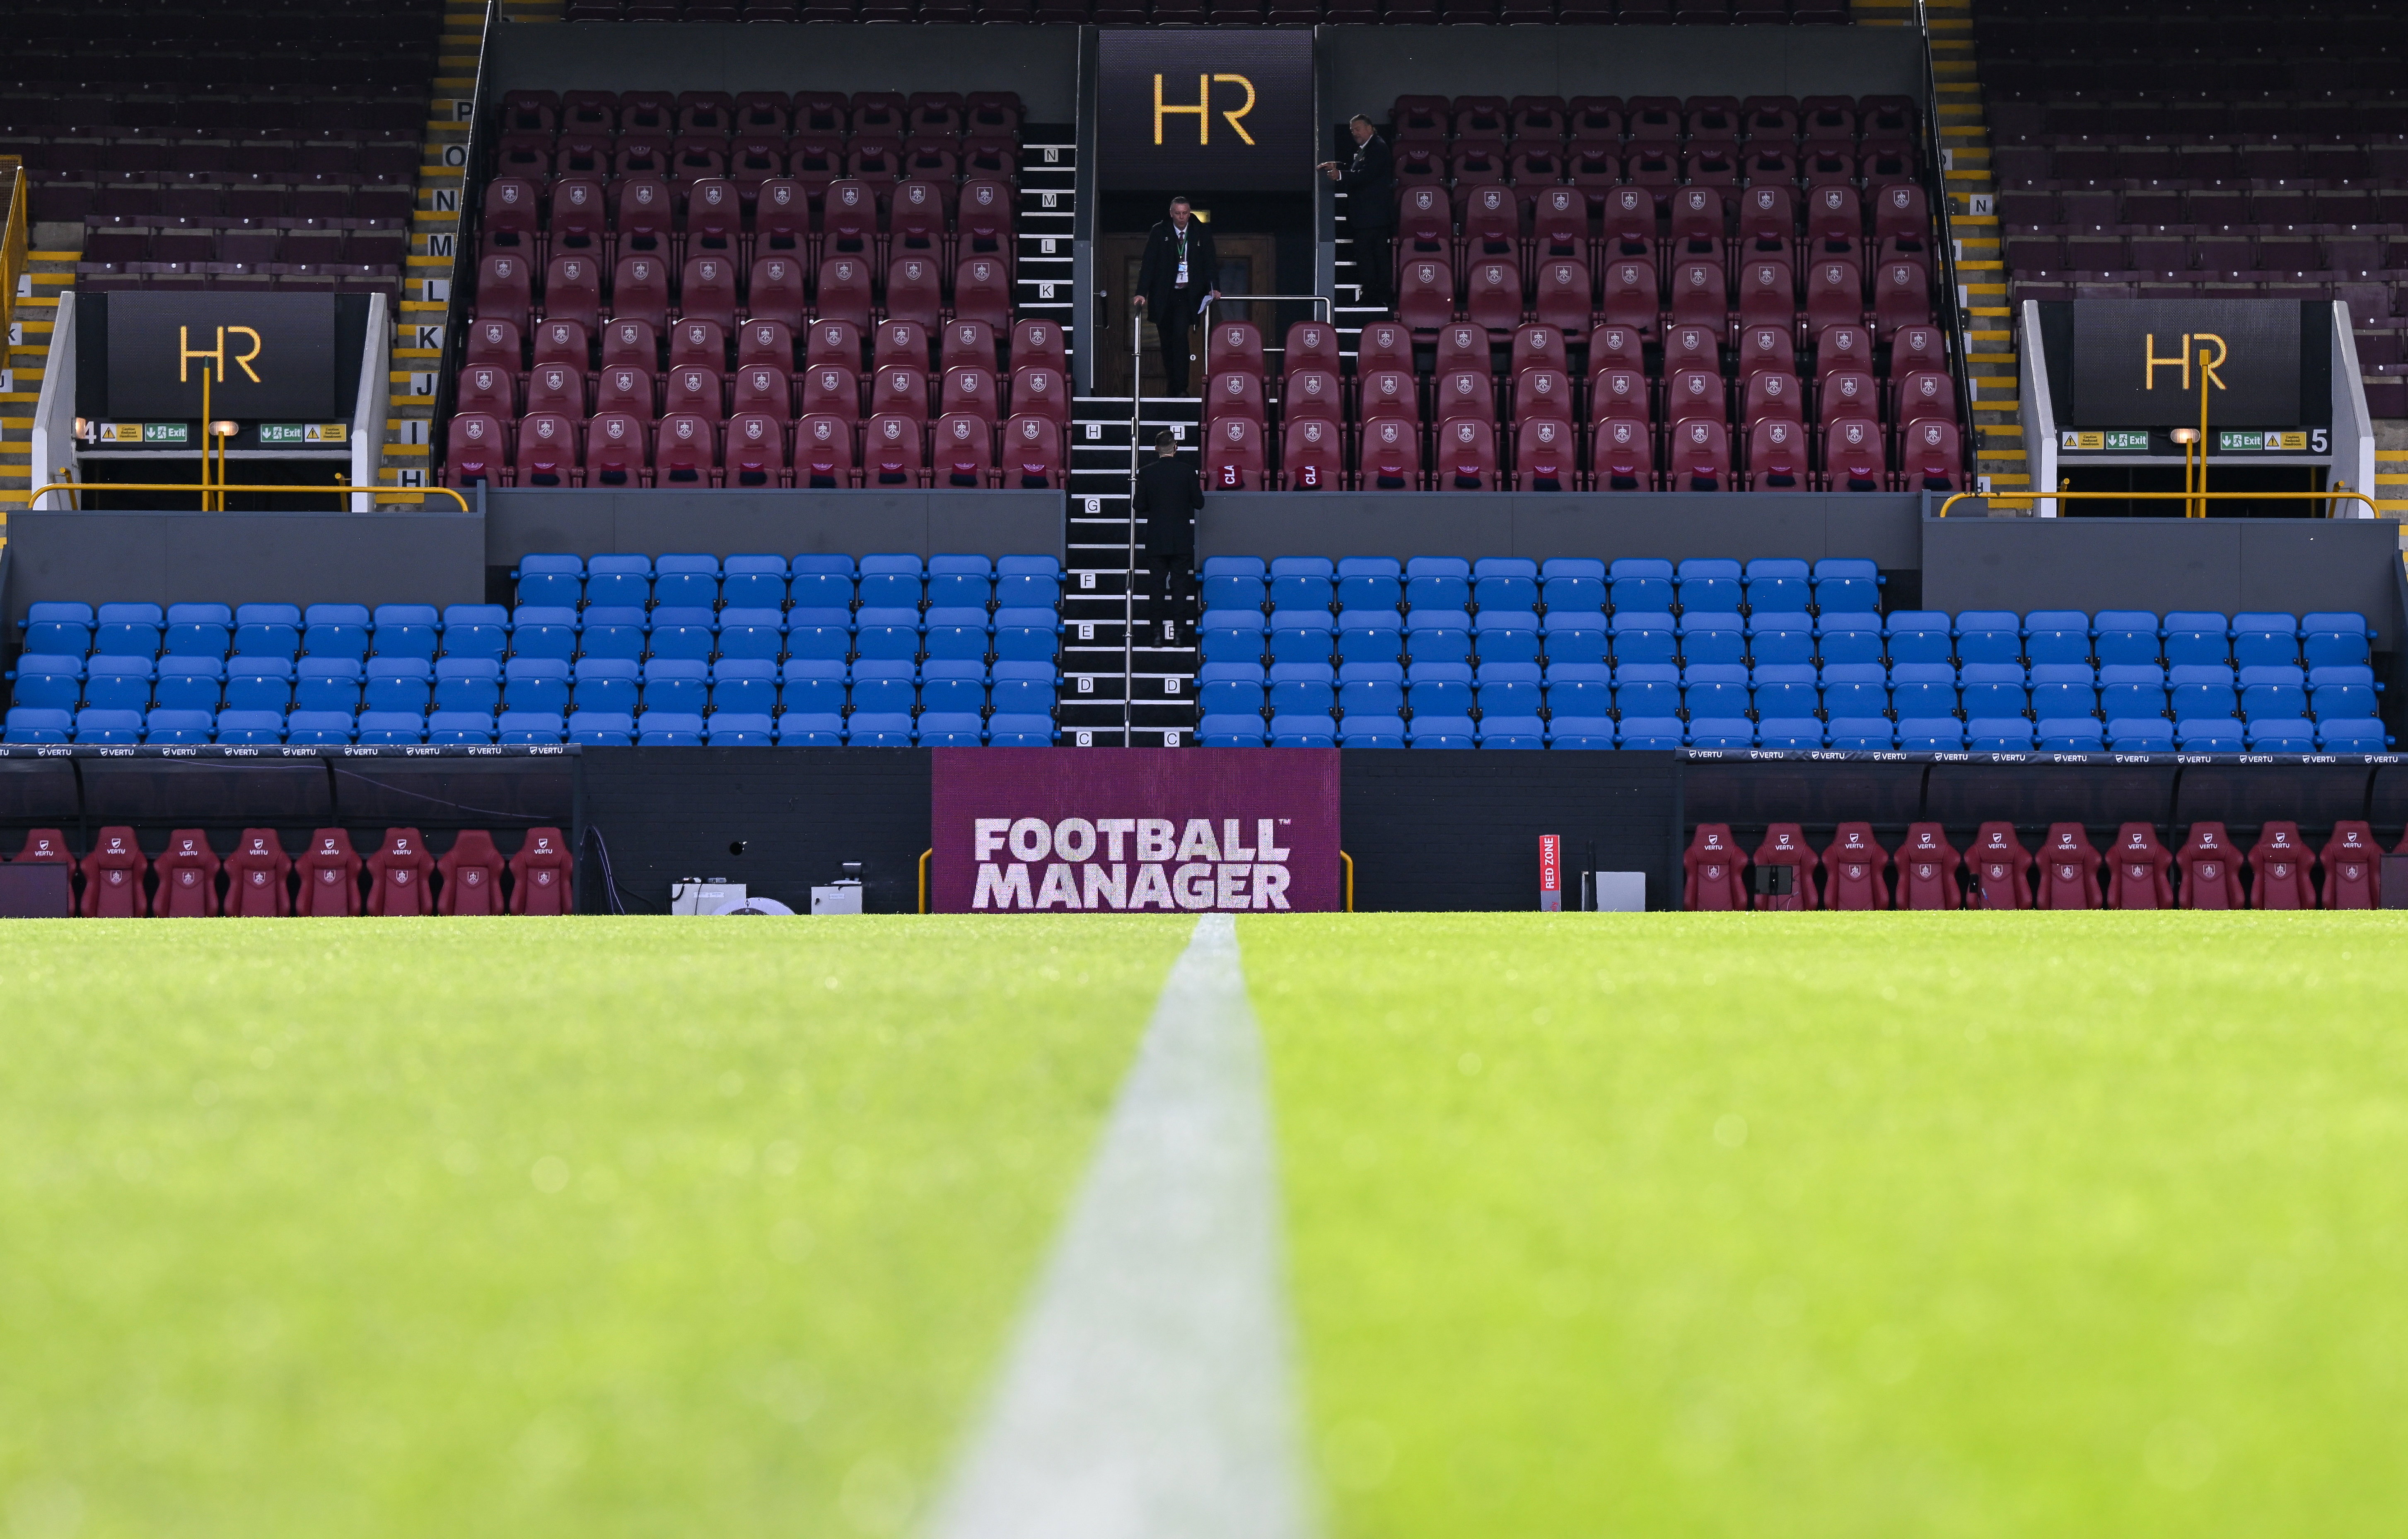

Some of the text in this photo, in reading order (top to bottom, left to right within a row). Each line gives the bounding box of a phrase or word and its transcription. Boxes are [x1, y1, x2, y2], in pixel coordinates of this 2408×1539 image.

[457, 102, 473, 121] P
[1154, 73, 1255, 145] HR
[445, 146, 466, 167] O
[1047, 150, 1056, 161] N
[437, 190, 455, 211] N
[1044, 195, 1055, 205] M
[1976, 200, 1986, 212] N
[430, 236, 452, 256] M
[1045, 241, 1053, 251] L
[428, 281, 444, 302] L
[1043, 285, 1051, 296] K
[420, 327, 438, 349] K
[180, 326, 261, 382] HR
[2146, 333, 2227, 390] HR
[417, 374, 432, 396] J
[84, 421, 97, 444] 4
[168, 428, 186, 437] Exit
[284, 428, 301, 437] Exit
[412, 422, 417, 445] I
[1089, 426, 1098, 437] H
[2130, 436, 2146, 445] Exit
[2244, 436, 2261, 445] Exit
[2311, 429, 2327, 452] 5
[402, 471, 420, 487] H
[1087, 500, 1097, 511] G
[1084, 575, 1092, 586] F
[1082, 626, 1090, 637] E
[1081, 679, 1090, 690] D
[1168, 680, 1177, 691] D
[1079, 733, 1089, 744] C
[1167, 733, 1177, 744] C
[974, 817, 1290, 862] FOOTBALL
[1544, 837, 1554, 889] RED ZONE
[972, 863, 1291, 909] MANAGER
